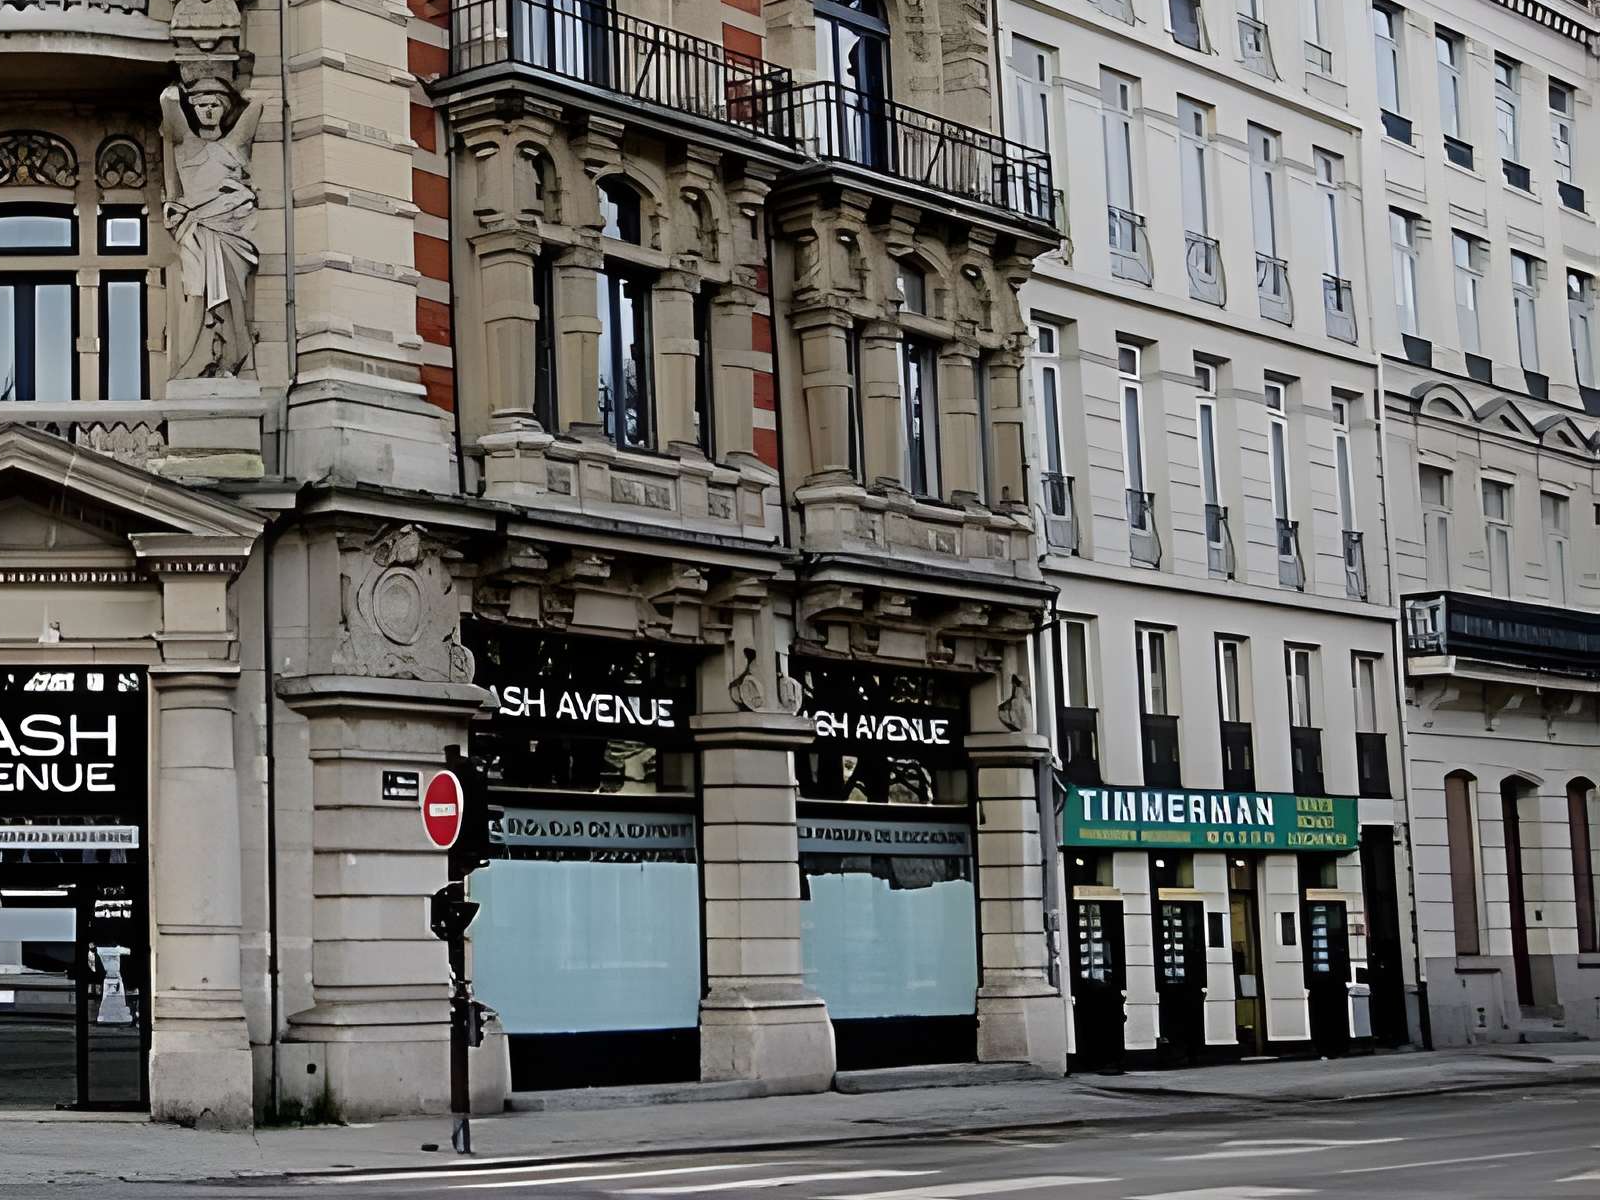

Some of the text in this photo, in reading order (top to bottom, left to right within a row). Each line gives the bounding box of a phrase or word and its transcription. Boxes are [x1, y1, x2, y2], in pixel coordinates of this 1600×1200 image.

[556, 691, 675, 728] AVENUE
[856, 714, 951, 745] AVENUE
[1078, 789, 1275, 826] TIMMERMAN
